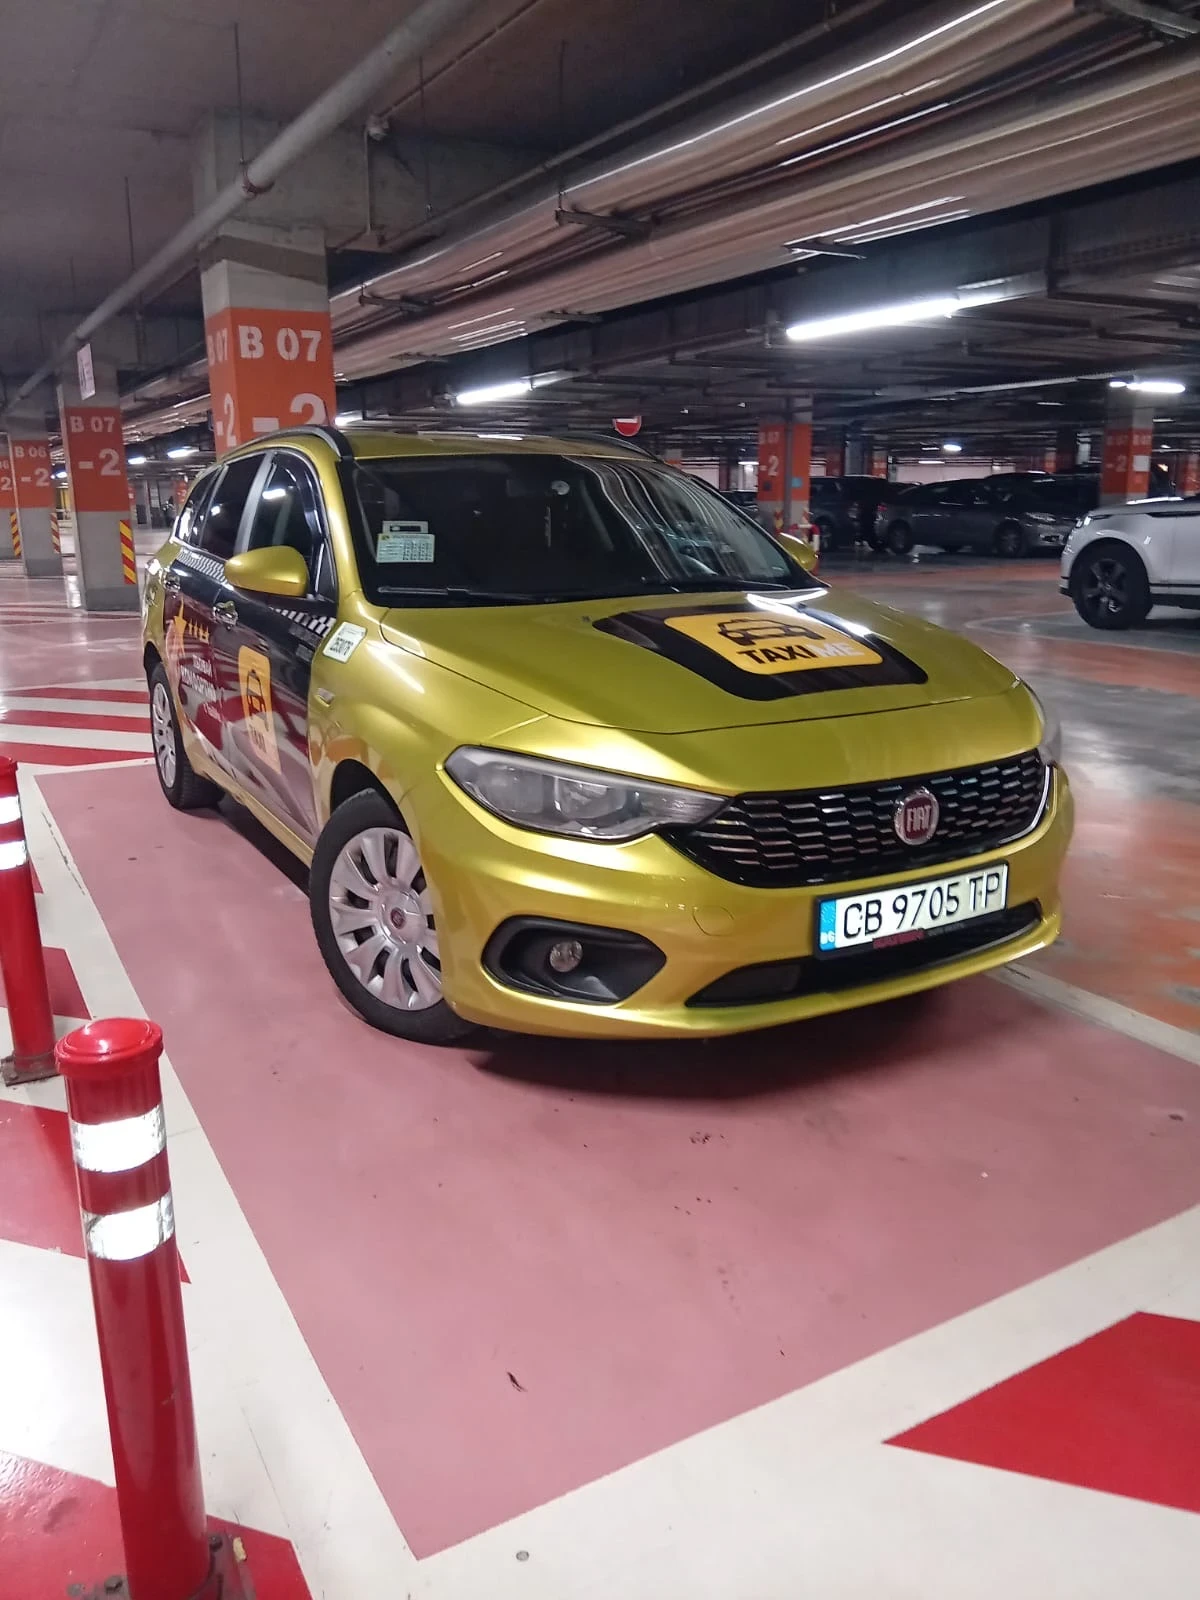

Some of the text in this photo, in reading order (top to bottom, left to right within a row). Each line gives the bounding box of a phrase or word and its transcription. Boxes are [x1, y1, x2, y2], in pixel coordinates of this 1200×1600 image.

[238, 325, 322, 362] B 07
[69, 416, 116, 433] B 07
[14, 446, 24, 458] B
[906, 804, 932, 832] FIAT
[843, 899, 883, 940] CB
[891, 881, 960, 930] 9705
[966, 872, 1001, 912] TP
